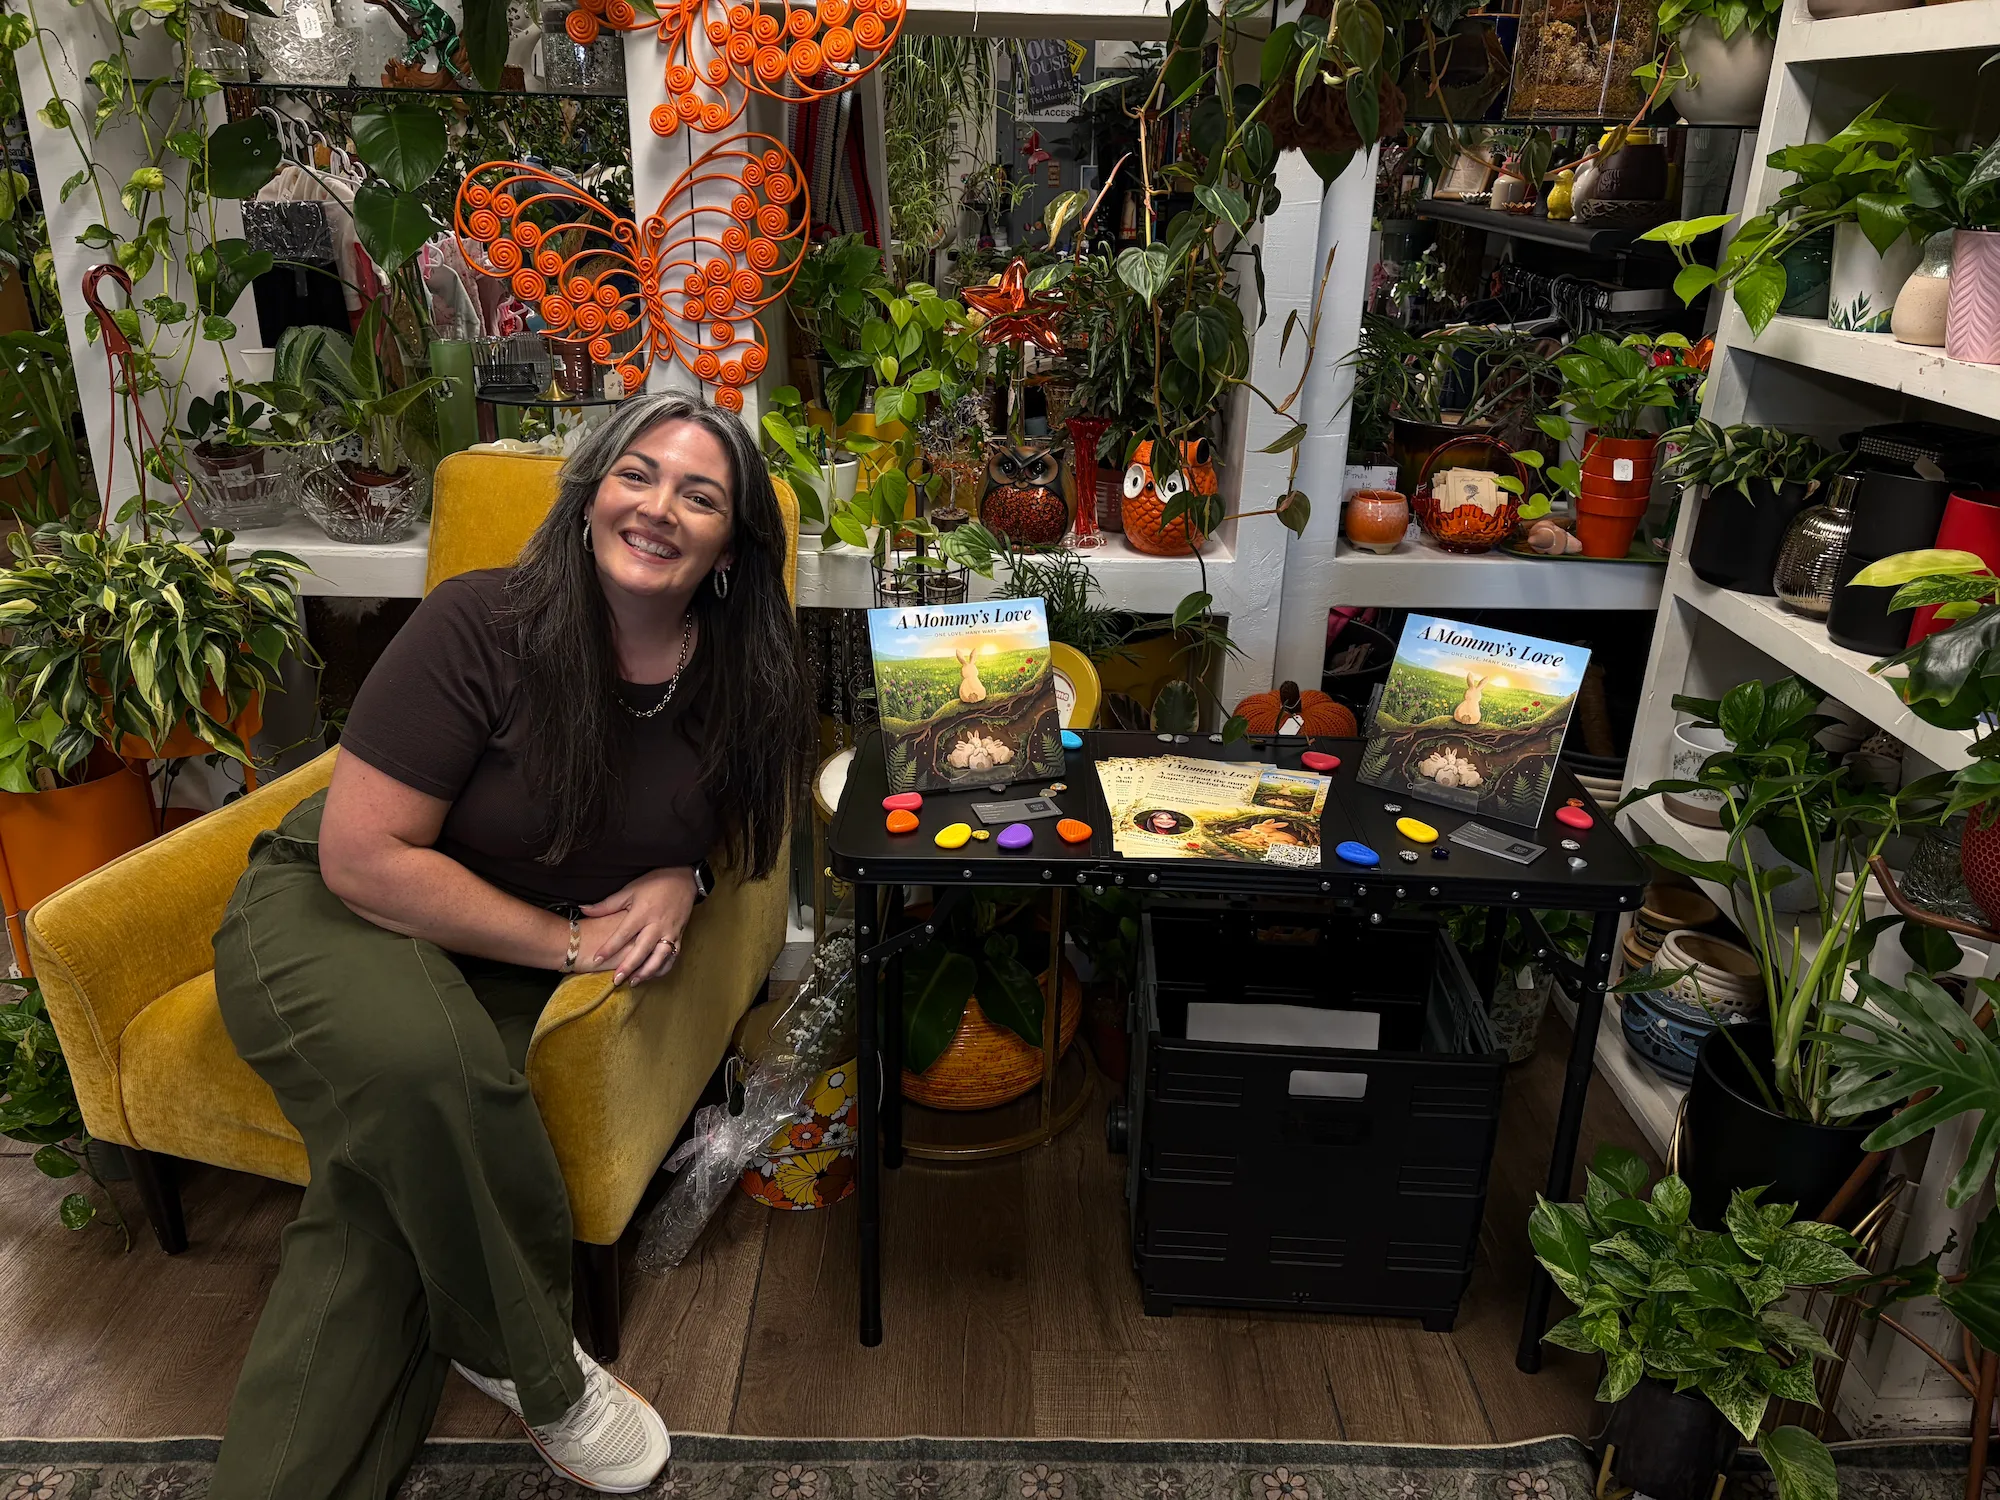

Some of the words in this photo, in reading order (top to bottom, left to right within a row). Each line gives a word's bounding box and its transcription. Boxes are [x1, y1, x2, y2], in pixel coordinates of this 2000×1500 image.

[1029, 53, 1070, 76] OUSE
[1028, 85, 1040, 95] We
[1041, 83, 1056, 95] Just
[1058, 79, 1073, 90] Pay
[1031, 94, 1043, 105] The
[1044, 109, 1076, 117] ACCESS
[896, 617, 908, 630] A
[913, 609, 990, 628] Mommy's
[994, 608, 1032, 623] Love
[1417, 626, 1432, 640] A
[1434, 628, 1517, 658] Mommy's
[1519, 645, 1565, 668] Love
[1463, 653, 1481, 662] LOVE,
[1482, 657, 1500, 665] MANY
[1502, 661, 1518, 669] WAYS
[1174, 764, 1228, 776] Mommy's
[1229, 771, 1256, 780] Love
[1156, 775, 1184, 783] shapes
[1196, 780, 1219, 788] being
